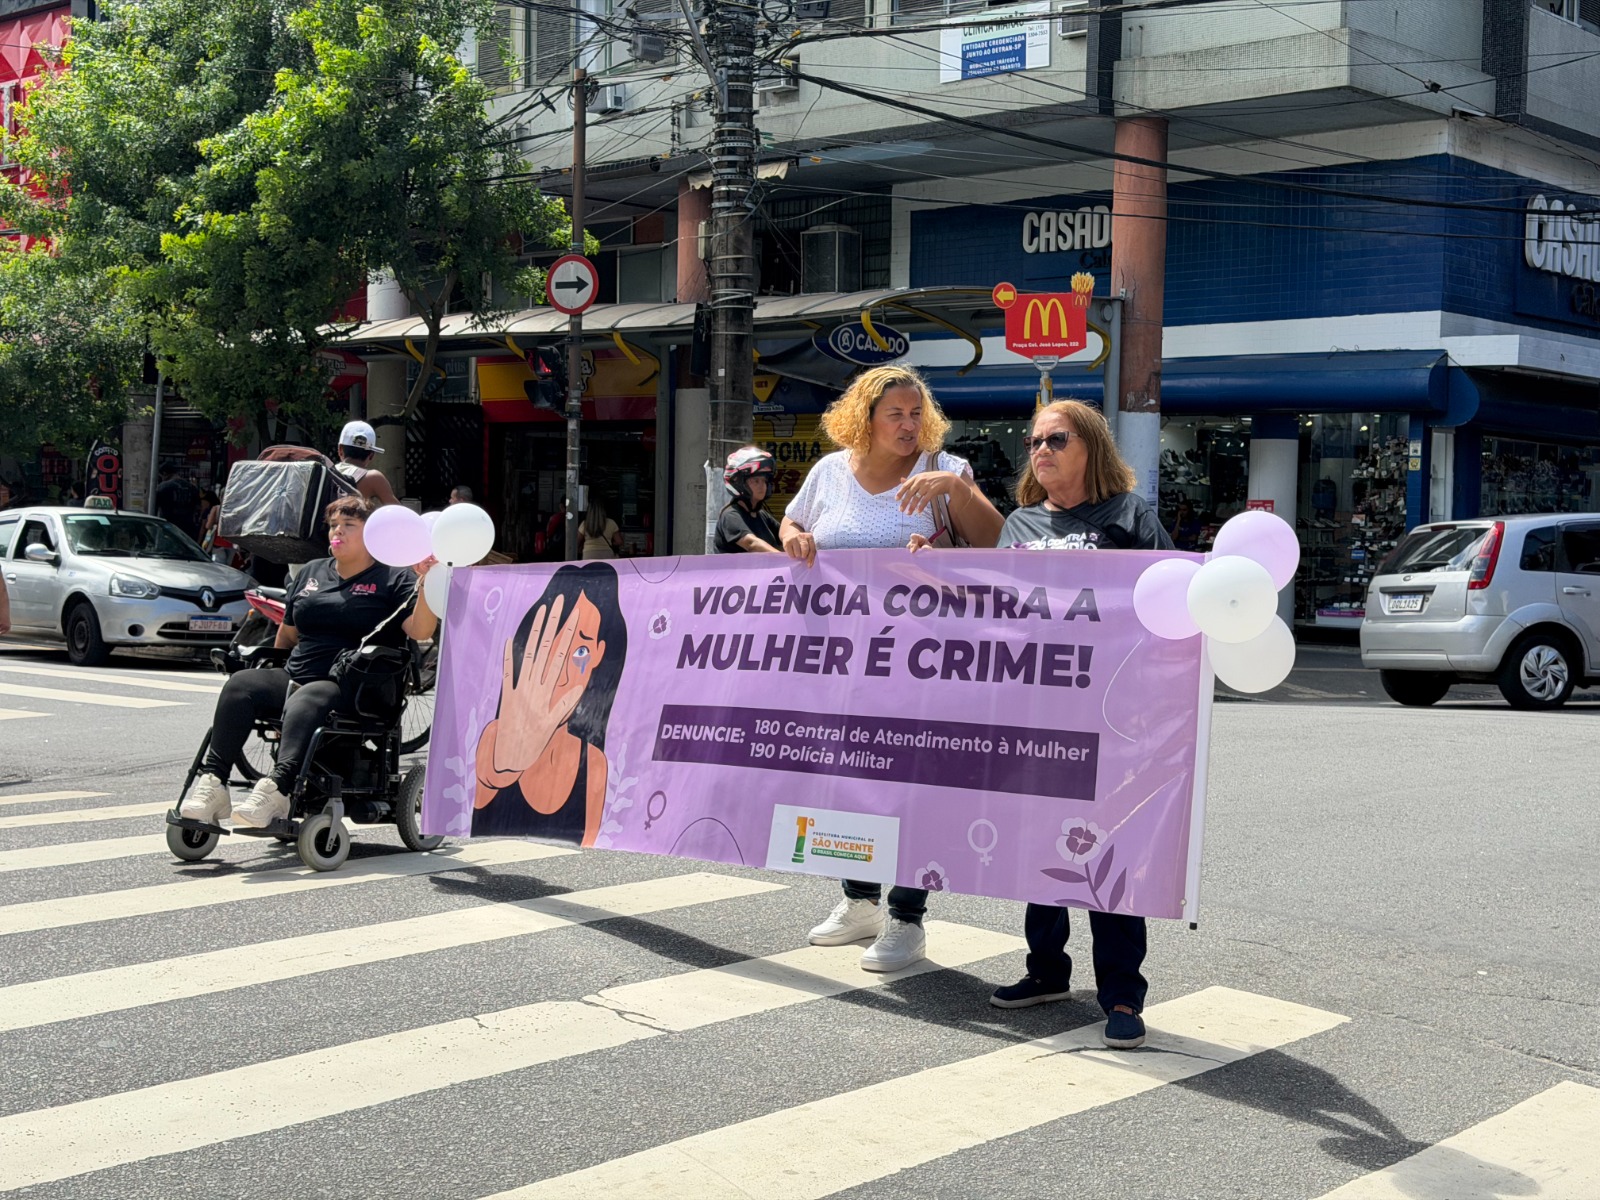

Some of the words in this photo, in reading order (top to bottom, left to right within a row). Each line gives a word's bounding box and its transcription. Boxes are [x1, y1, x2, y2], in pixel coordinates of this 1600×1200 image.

[963, 41, 988, 52] ENTIDADE
[988, 35, 1025, 47] CREDENCIADA
[966, 50, 983, 59] JUNTO
[983, 48, 991, 56] AO
[991, 43, 1022, 55] DETRAN-SP
[1022, 205, 1112, 254] CASAD
[693, 575, 870, 616] VIOLÊNCIA
[883, 584, 1052, 620] CONTRA
[1063, 588, 1101, 622] A
[676, 633, 854, 676] MULHER
[864, 625, 896, 677] É
[907, 637, 1094, 689] CRIME!
[661, 723, 746, 744] DENUNCIE:
[755, 719, 781, 736] 180
[784, 721, 846, 742] Central
[849, 726, 870, 744] de
[873, 728, 993, 753] Atendimento
[997, 736, 1010, 755] à
[1015, 738, 1090, 762] Mulher
[749, 742, 776, 759] 190
[779, 744, 834, 765] Polícia
[839, 750, 894, 770] Militar
[811, 837, 832, 848] SÃO
[834, 840, 874, 853] VICENTE
